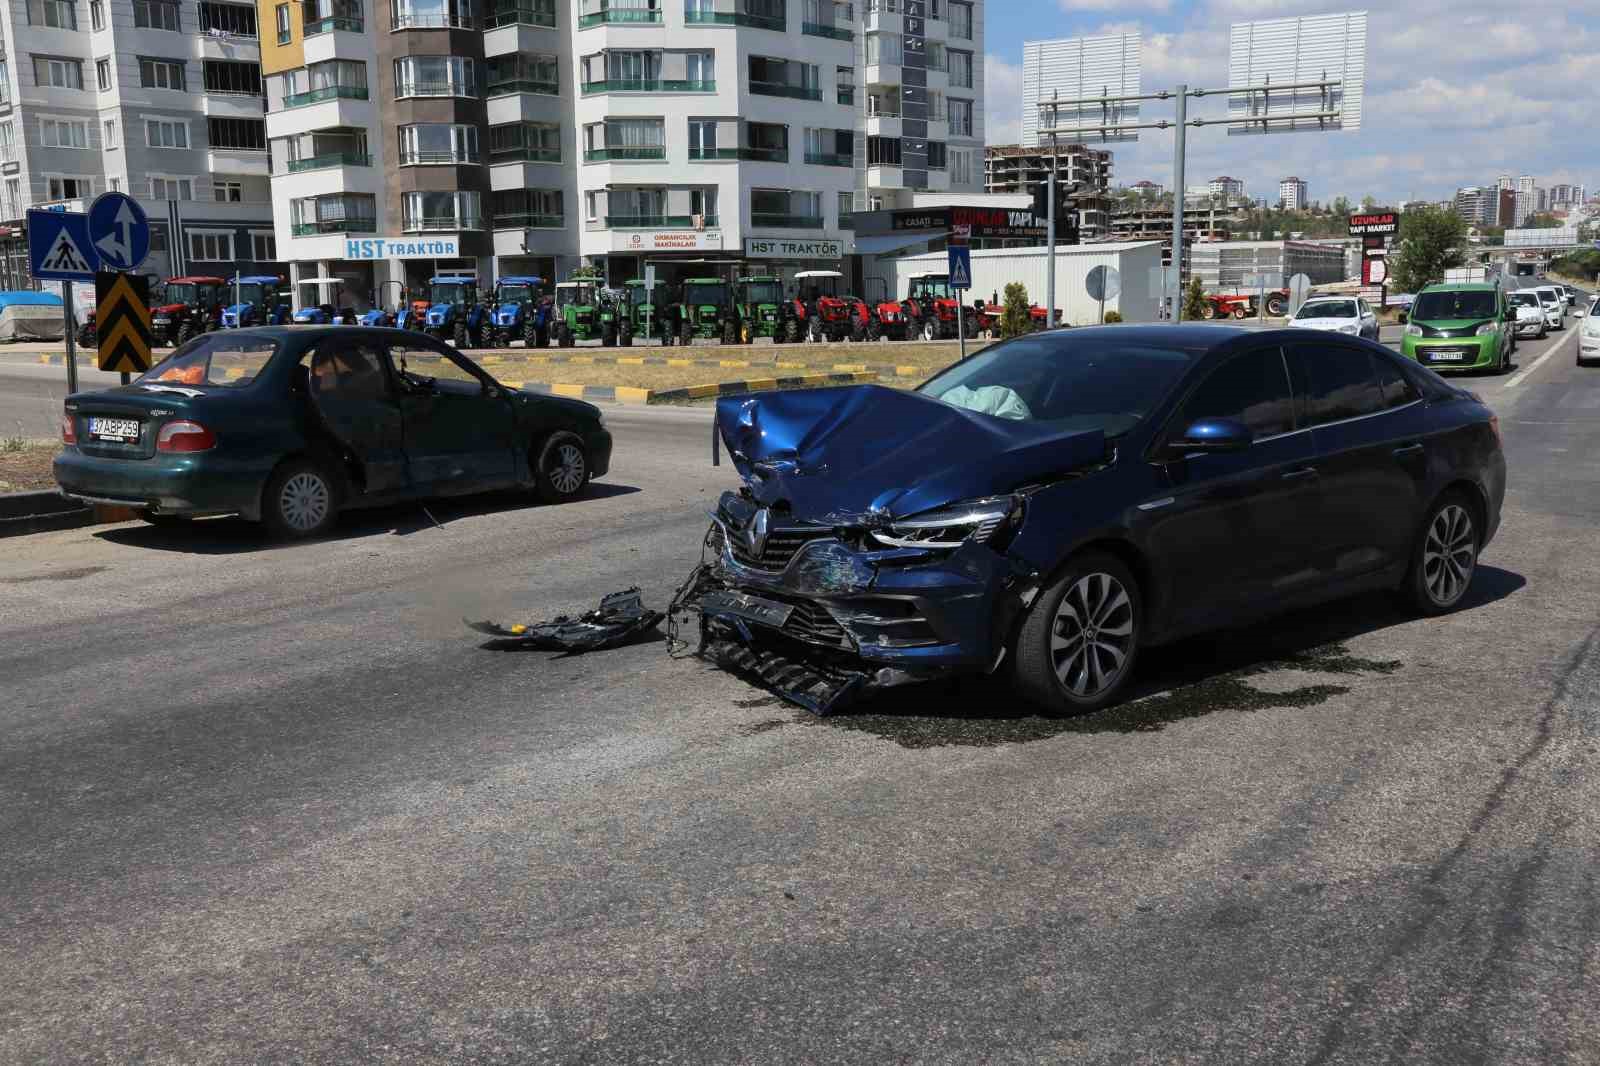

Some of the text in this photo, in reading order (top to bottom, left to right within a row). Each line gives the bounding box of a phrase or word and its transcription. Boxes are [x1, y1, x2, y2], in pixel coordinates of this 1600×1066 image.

[1008, 210, 1033, 227] YAPI
[1351, 214, 1393, 225] UZUNLAR
[1350, 224, 1395, 233] YAPI MARKET
[347, 240, 454, 258] HST TRAKTÖR
[751, 242, 838, 255] HST TRAKTÖR
